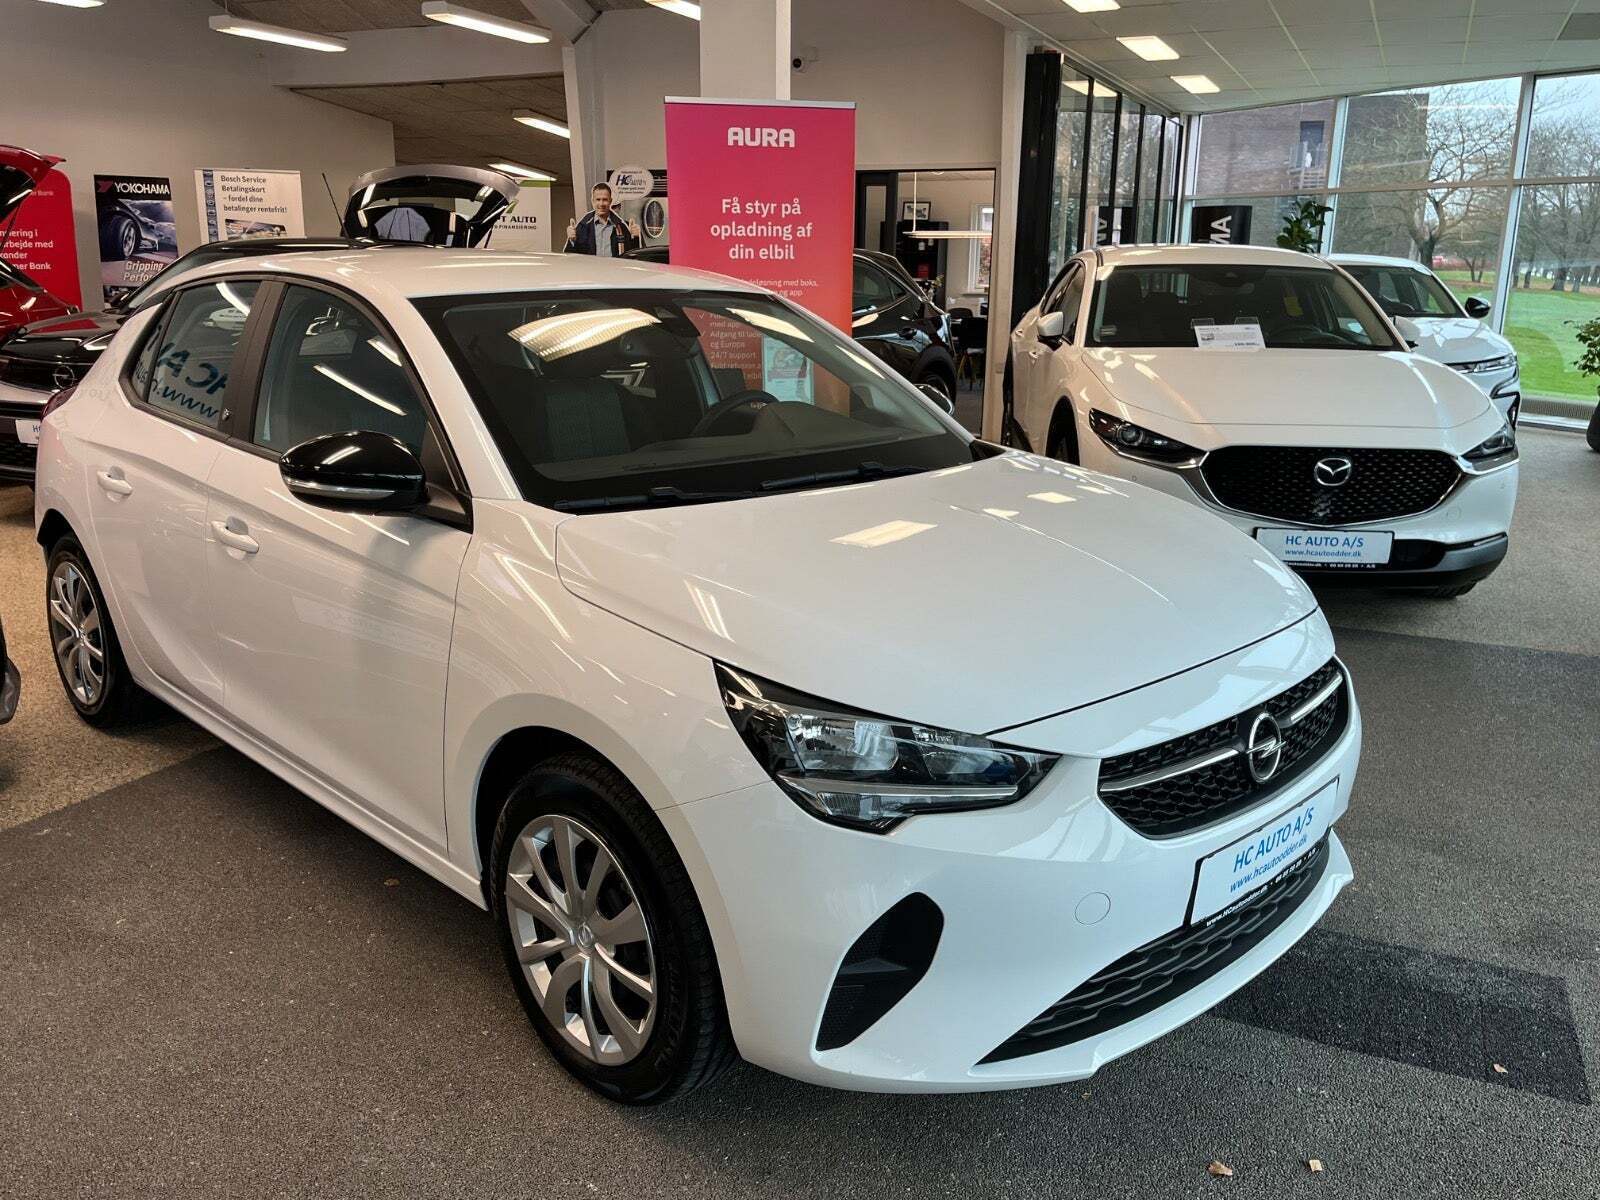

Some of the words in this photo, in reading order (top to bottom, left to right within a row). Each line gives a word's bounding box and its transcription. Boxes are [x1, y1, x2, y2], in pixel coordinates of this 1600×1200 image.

[727, 127, 795, 148] AURA
[220, 175, 241, 183] Bosch
[114, 182, 170, 194] YOKOHAMA
[721, 196, 741, 214] Få
[745, 200, 776, 217] styr
[781, 198, 801, 217] på
[710, 222, 792, 240] opladning
[796, 222, 813, 237] af
[35, 240, 53, 248] med
[729, 245, 755, 260] din
[759, 245, 795, 260] elbil
[30, 262, 51, 270] Bank
[126, 261, 163, 271] Gripping
[124, 271, 152, 281] Perfo
[730, 352, 756, 360] support
[1285, 535, 1302, 546] HC
[1305, 536, 1339, 547] AUTO
[1342, 537, 1365, 549] A/S
[1285, 549, 1362, 558] www.hcautoodder.dk
[1233, 844, 1255, 873] HC
[1255, 822, 1292, 862] AUTO
[1292, 806, 1315, 835] A/S
[1229, 833, 1309, 893] www.hcautoodder.dk
